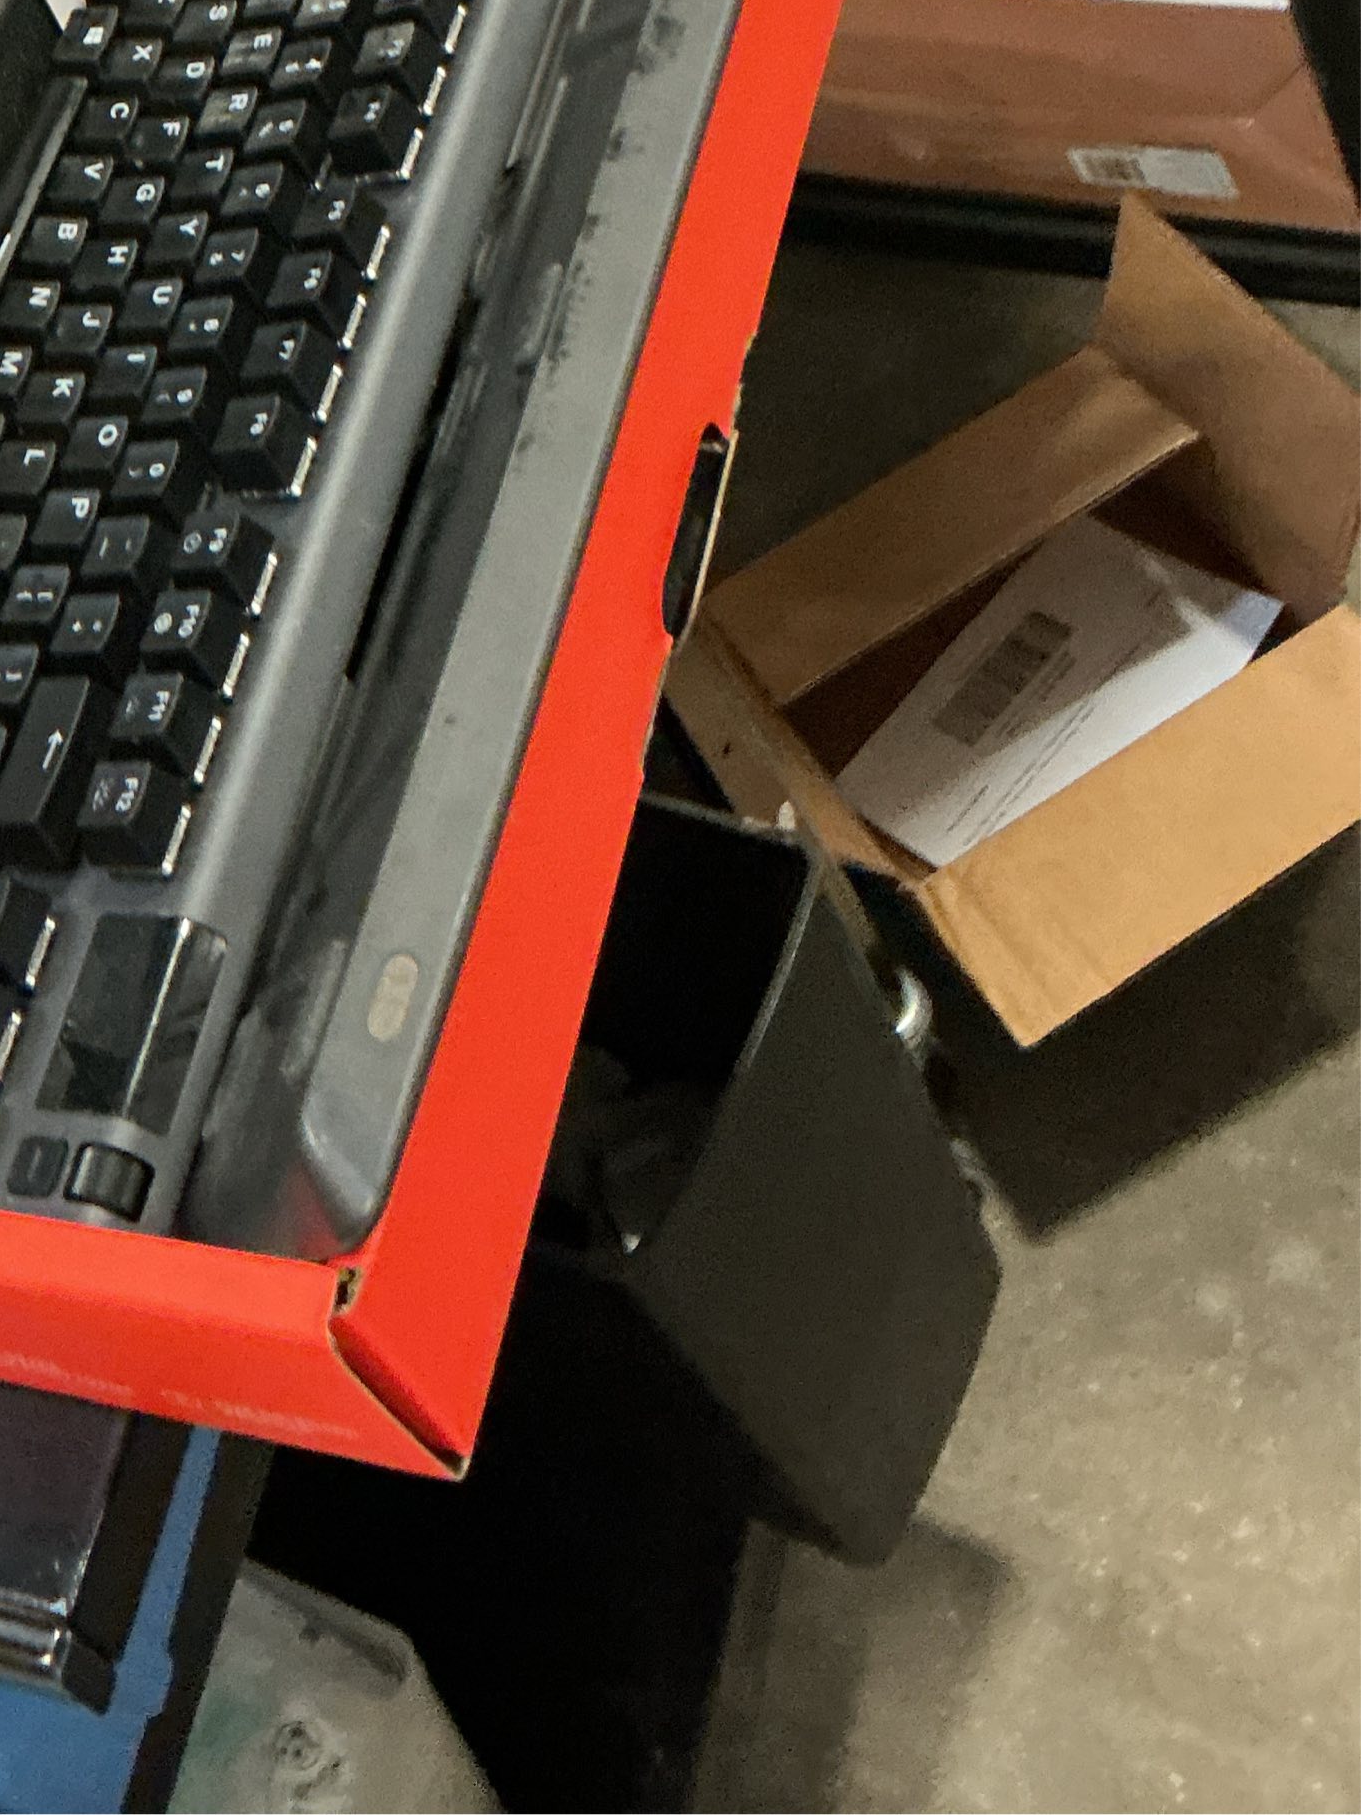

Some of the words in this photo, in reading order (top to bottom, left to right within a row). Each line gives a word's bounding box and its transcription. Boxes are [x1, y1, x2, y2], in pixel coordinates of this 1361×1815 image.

[208, 4, 228, 22] S
[253, 34, 274, 50] E
[132, 44, 154, 62] X
[186, 60, 206, 79] D
[110, 101, 130, 120] C
[228, 92, 250, 112] R
[162, 120, 182, 137] F
[84, 162, 105, 181] V
[205, 154, 225, 173] T
[135, 182, 156, 203] G
[57, 221, 79, 241] B
[179, 218, 200, 237] Y
[107, 245, 129, 265] H
[29, 287, 52, 308] N
[152, 285, 174, 305] U
[82, 311, 101, 328] J
[0, 351, 23, 376] M
[52, 377, 75, 398] K
[97, 422, 118, 448] O
[22, 448, 46, 467] L
[71, 497, 91, 519] P
